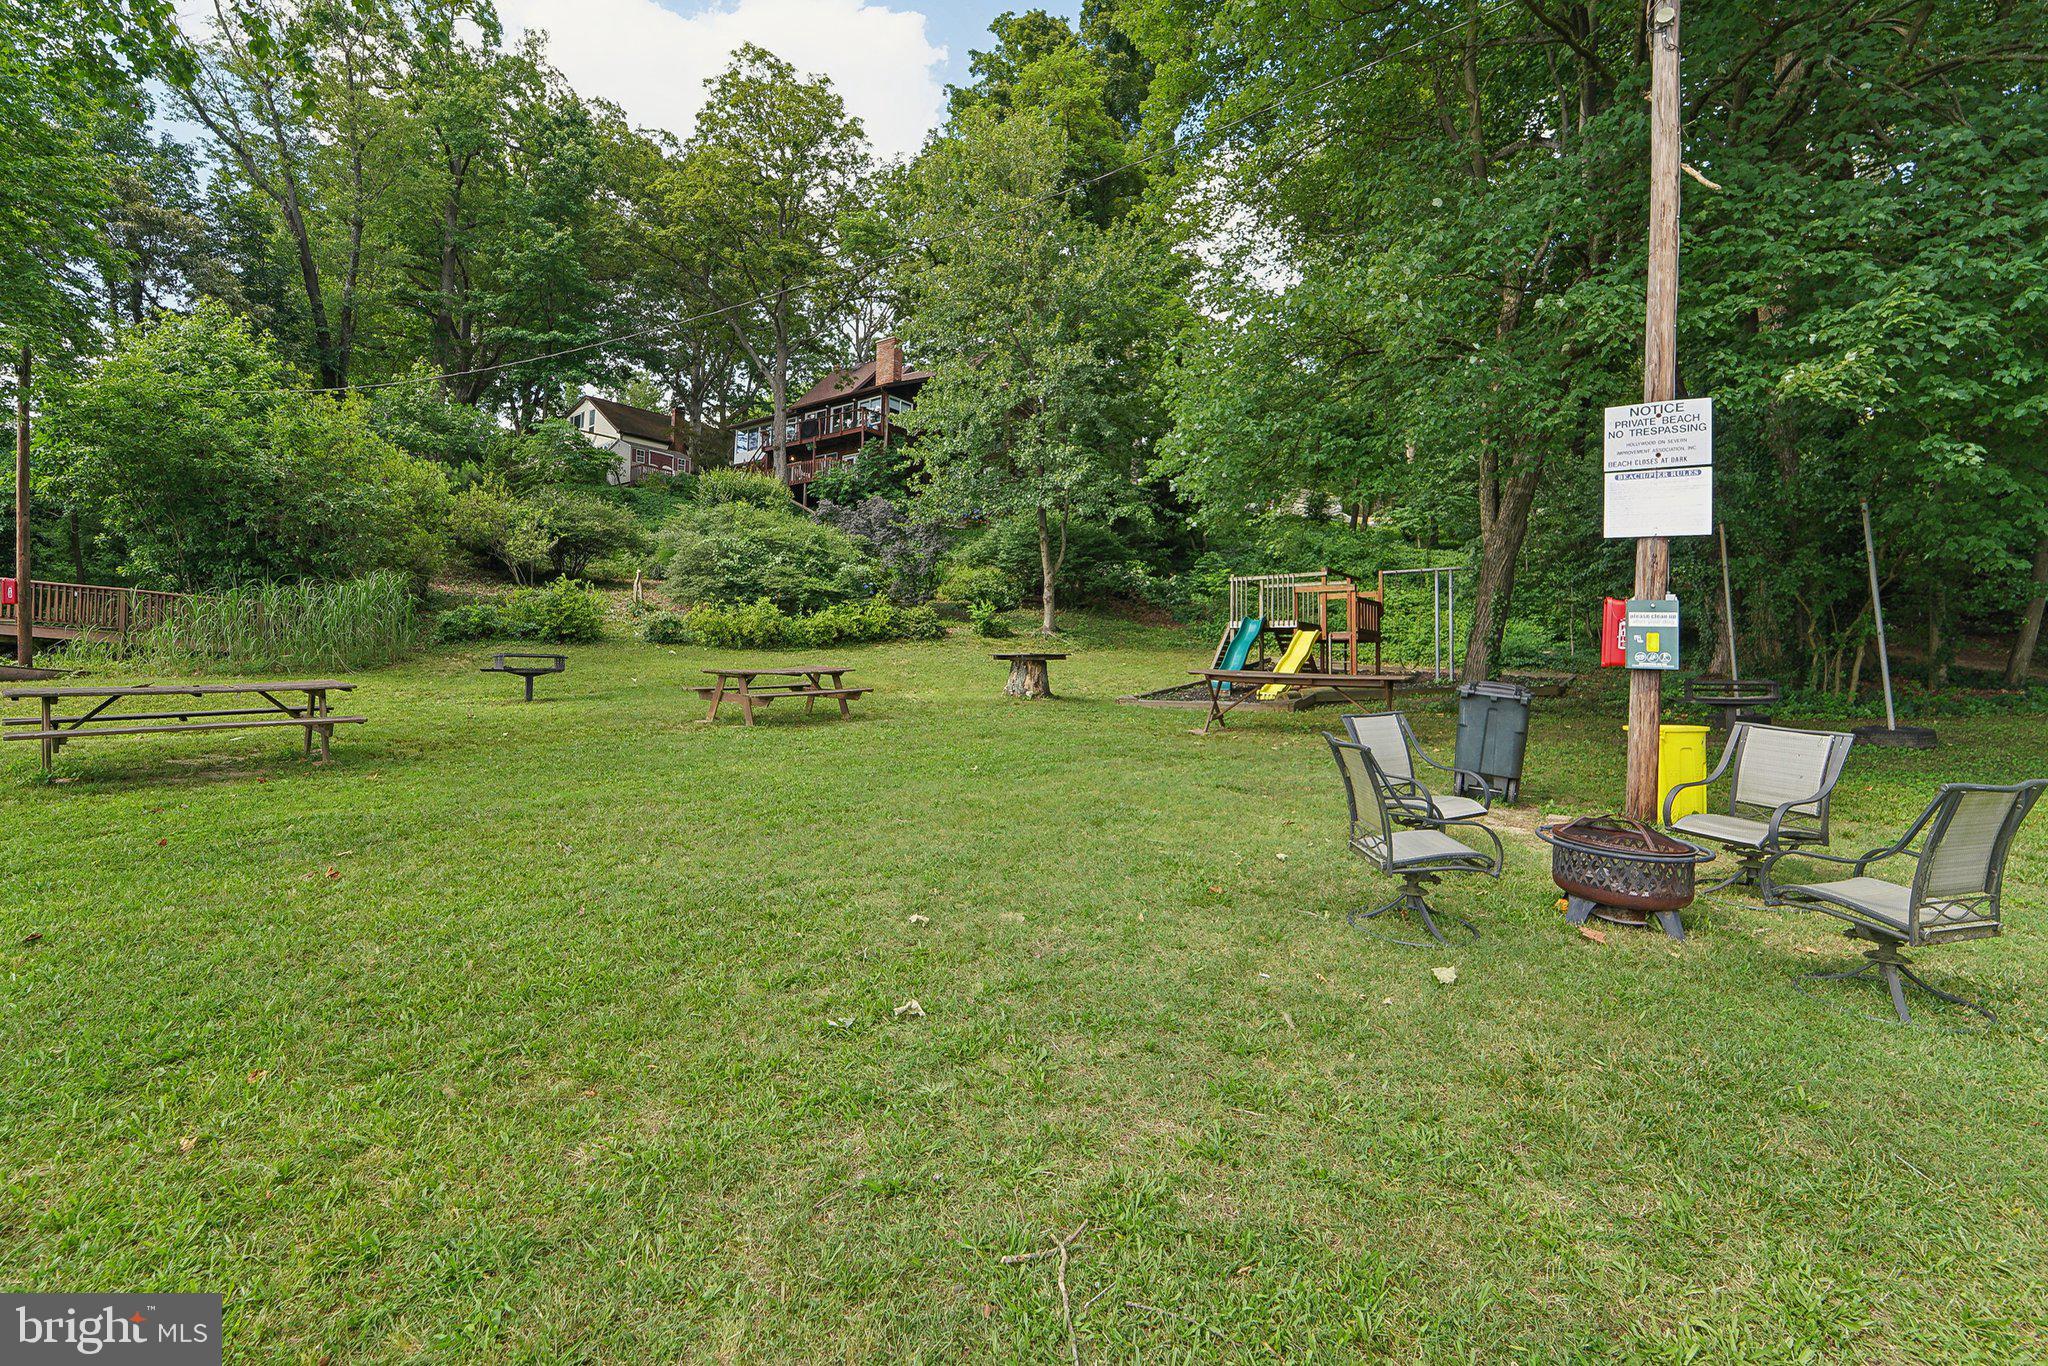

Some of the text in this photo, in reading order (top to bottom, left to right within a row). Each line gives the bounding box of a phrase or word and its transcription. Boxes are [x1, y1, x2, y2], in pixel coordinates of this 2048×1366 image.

[1630, 402, 1684, 416] NOTICE
[1615, 413, 1700, 429] PRIVATE BEACH
[1608, 422, 1707, 439] NO TRESPASSING
[1608, 460, 1632, 469] BEACH
[1634, 457, 1658, 466] CLOSES
[1670, 456, 1688, 464] DARK
